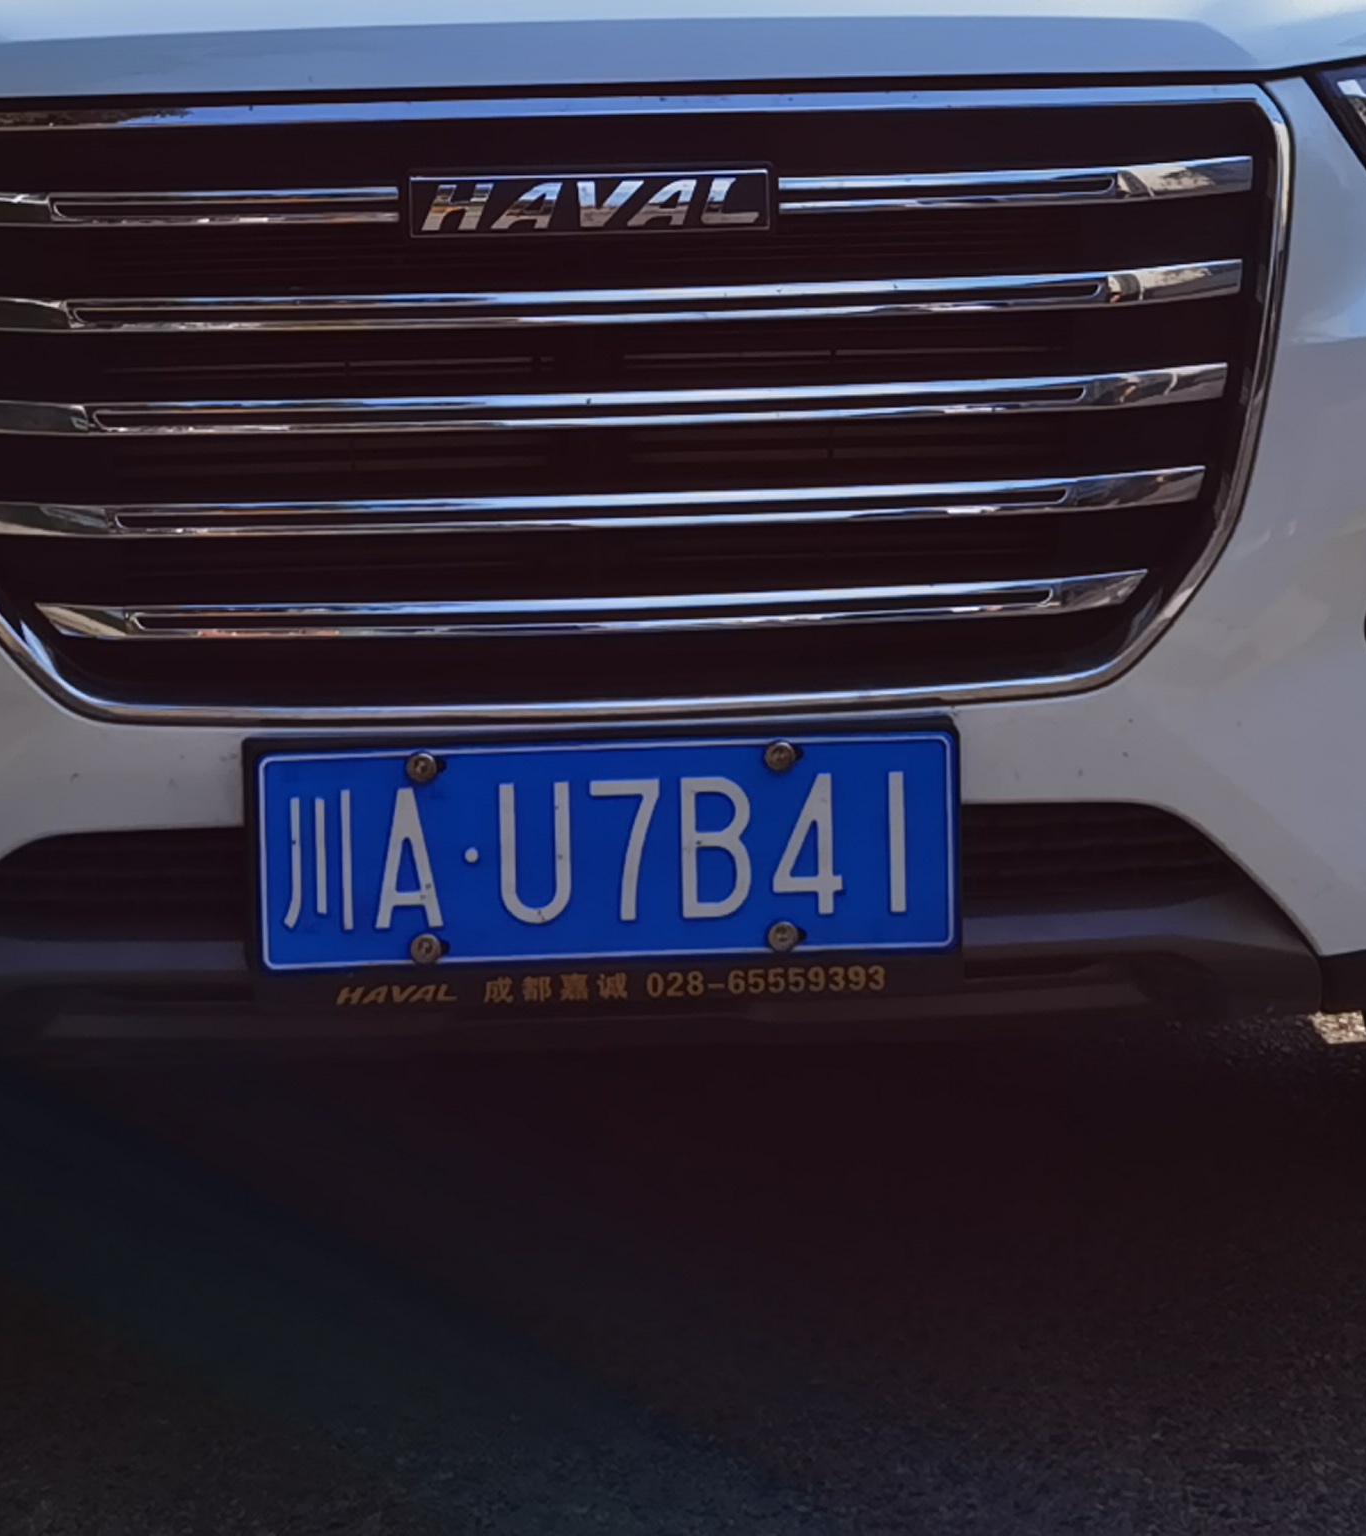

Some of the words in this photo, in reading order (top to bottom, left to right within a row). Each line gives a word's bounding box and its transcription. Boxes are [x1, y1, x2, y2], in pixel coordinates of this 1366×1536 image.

[421, 177, 760, 231] HAVAL
[337, 983, 459, 1007] HAVAL
[483, 972, 630, 1004] 成都嘉诚
[646, 965, 887, 998] 028-65559393
